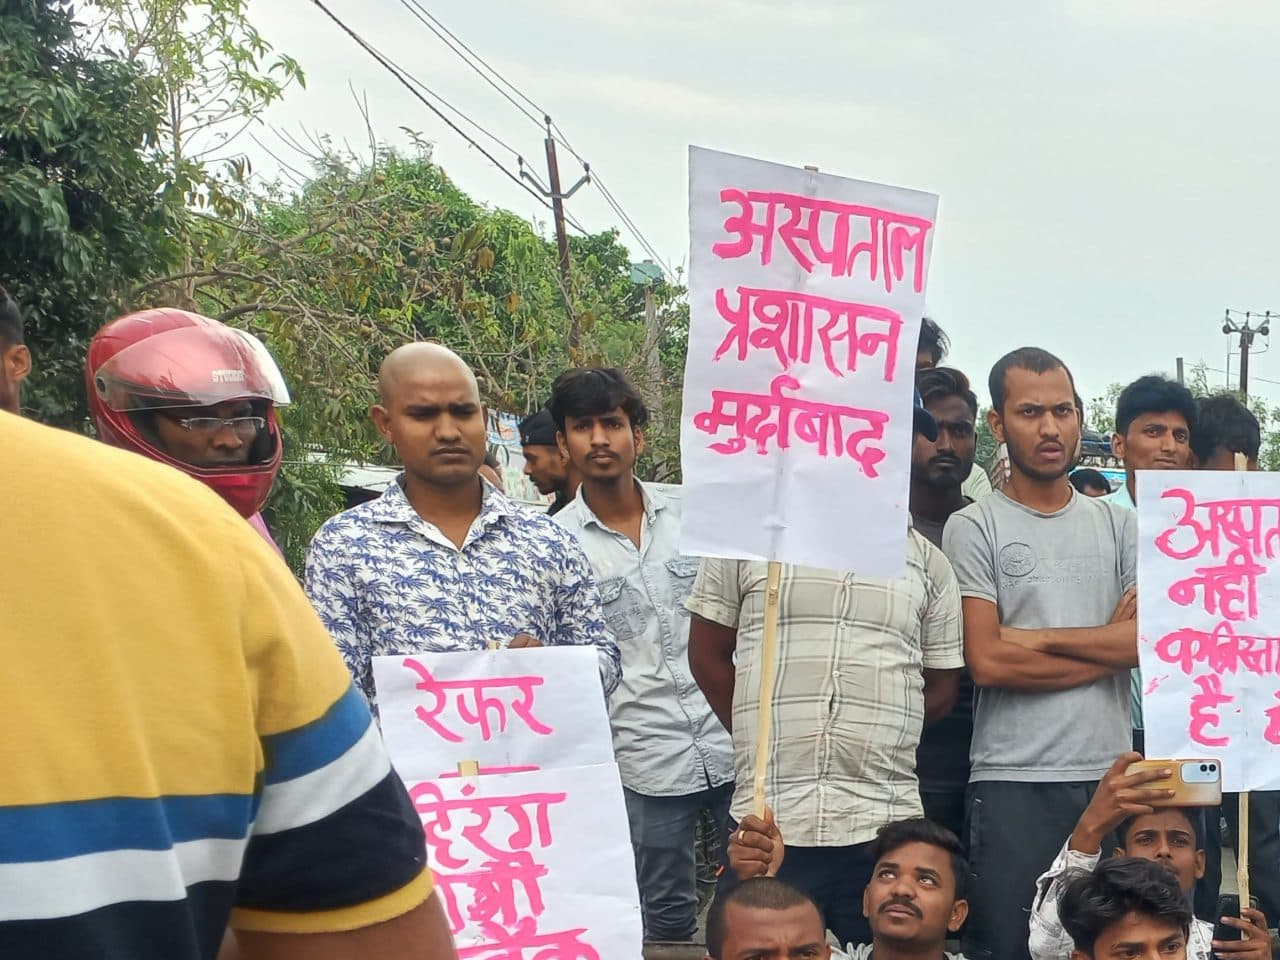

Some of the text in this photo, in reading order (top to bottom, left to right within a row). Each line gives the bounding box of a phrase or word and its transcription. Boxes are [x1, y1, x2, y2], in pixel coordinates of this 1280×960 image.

[712, 188, 932, 293] अस्पताल
[713, 286, 904, 382] प्रशासन
[403, 658, 553, 743] रेफर
